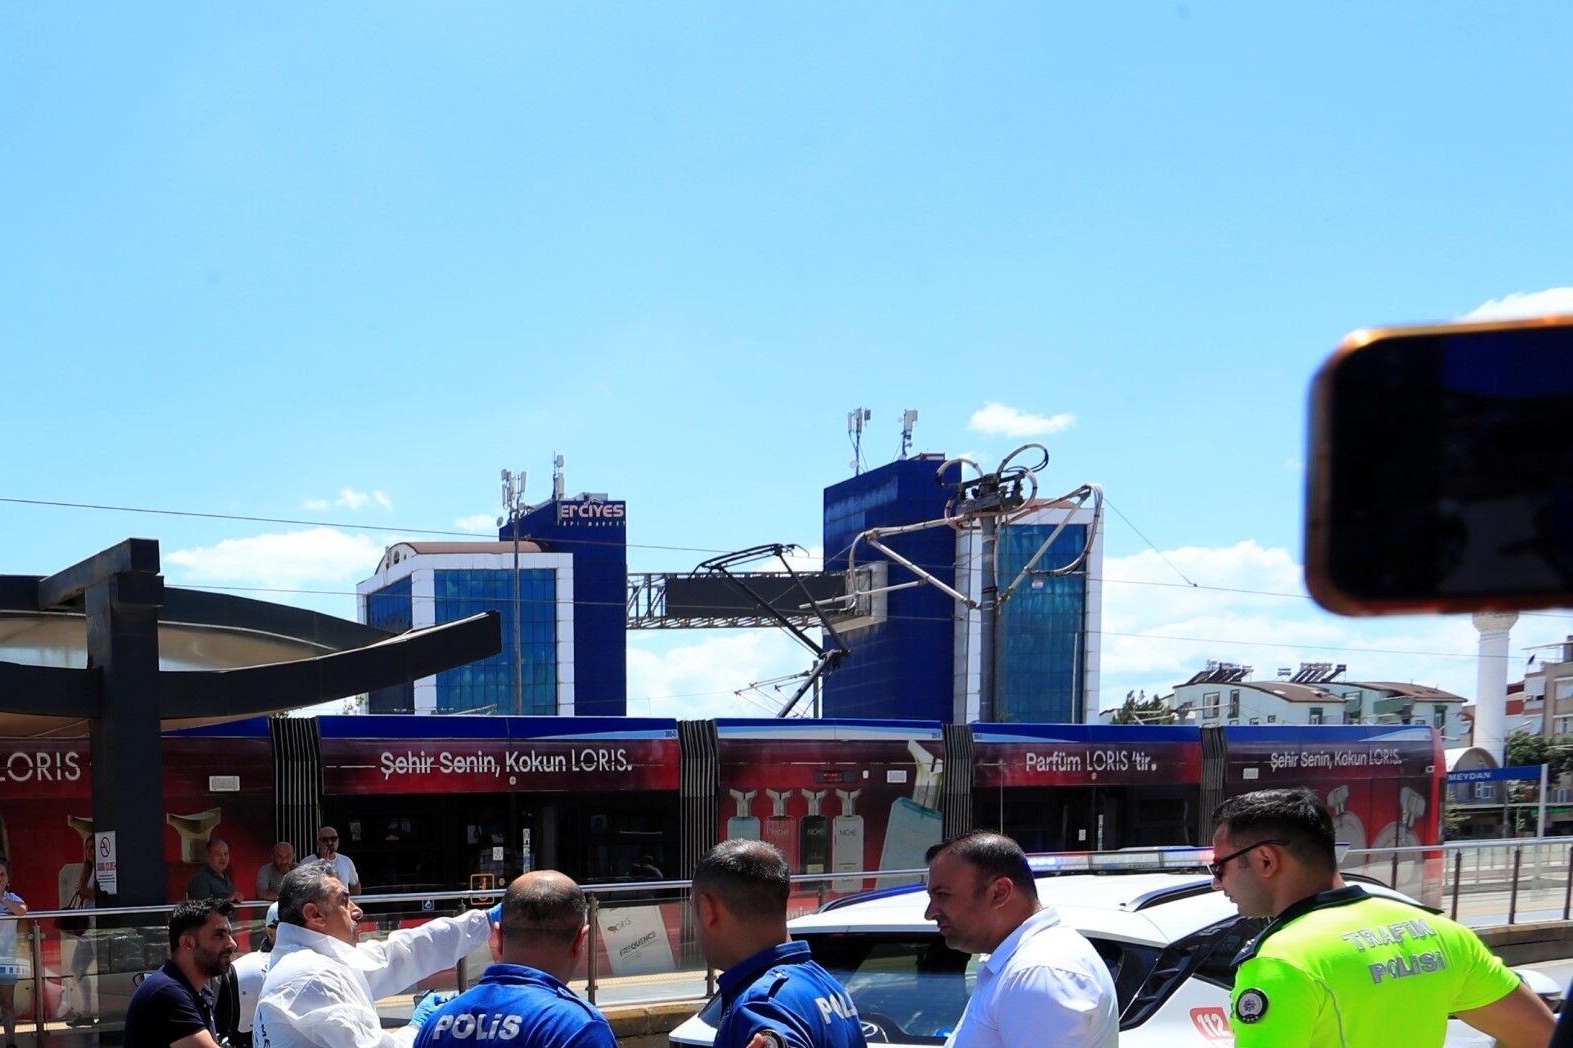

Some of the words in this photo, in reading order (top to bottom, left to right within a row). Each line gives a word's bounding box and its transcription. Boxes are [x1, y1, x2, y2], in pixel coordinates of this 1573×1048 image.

[381, 750, 434, 780] Şehir
[439, 750, 500, 778] Senin,
[506, 751, 566, 773] Kokun
[1026, 752, 1081, 772] Parfüm
[1087, 751, 1128, 771] LORIS
[1270, 751, 1298, 772] Şehir
[1301, 751, 1332, 769] Senin,
[1335, 750, 1367, 767] Kokun
[1448, 772, 1491, 780] MEYDAN
[815, 991, 858, 1025] POL
[1197, 1013, 1234, 1038] 112
